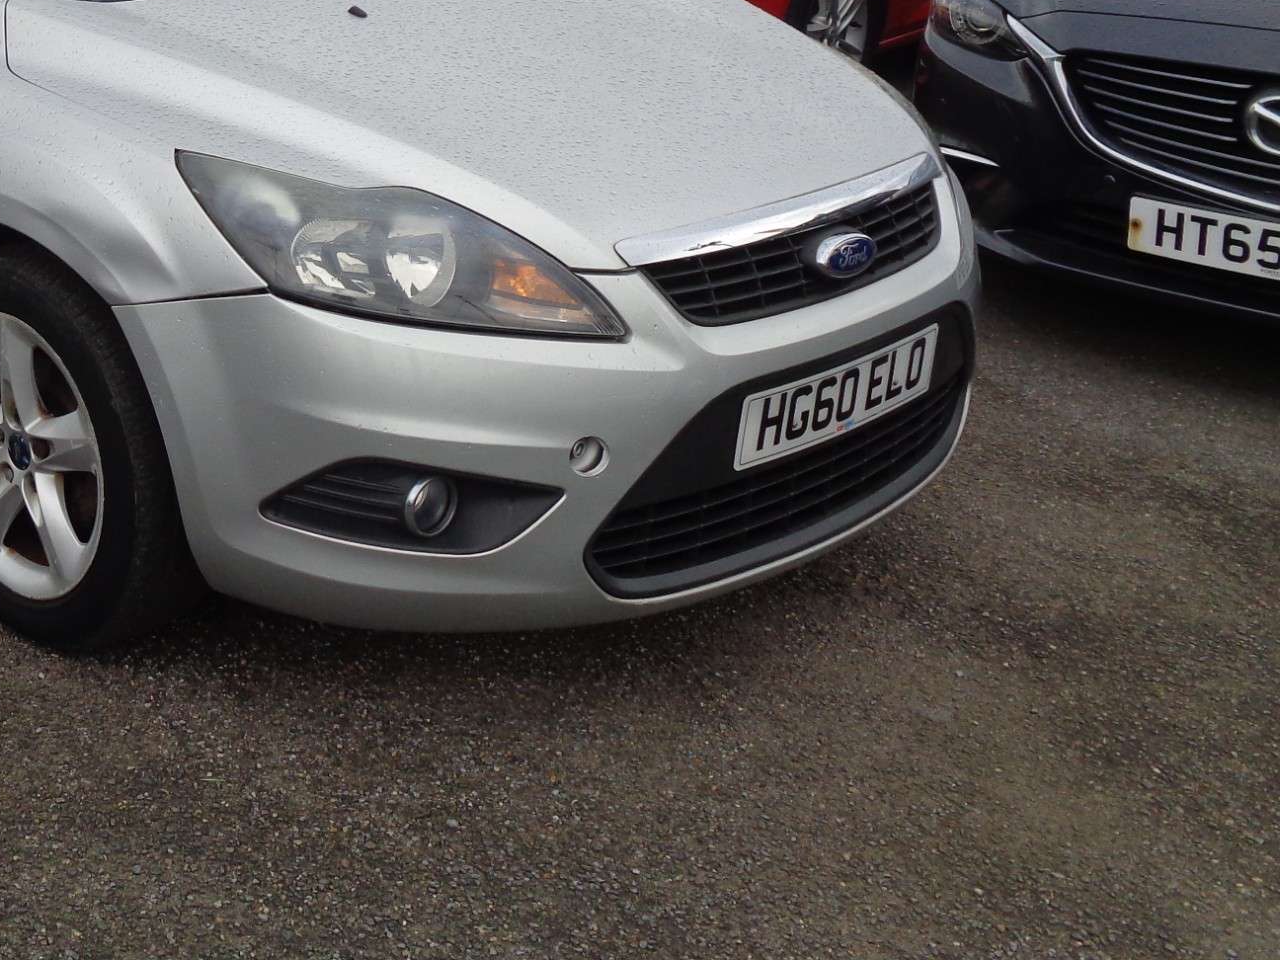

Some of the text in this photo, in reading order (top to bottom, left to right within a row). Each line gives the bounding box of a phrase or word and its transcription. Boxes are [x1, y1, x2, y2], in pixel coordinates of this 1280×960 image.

[840, 242, 869, 268] Ford
[1155, 208, 1280, 270] HT65
[755, 337, 927, 451] HG60 ELO
